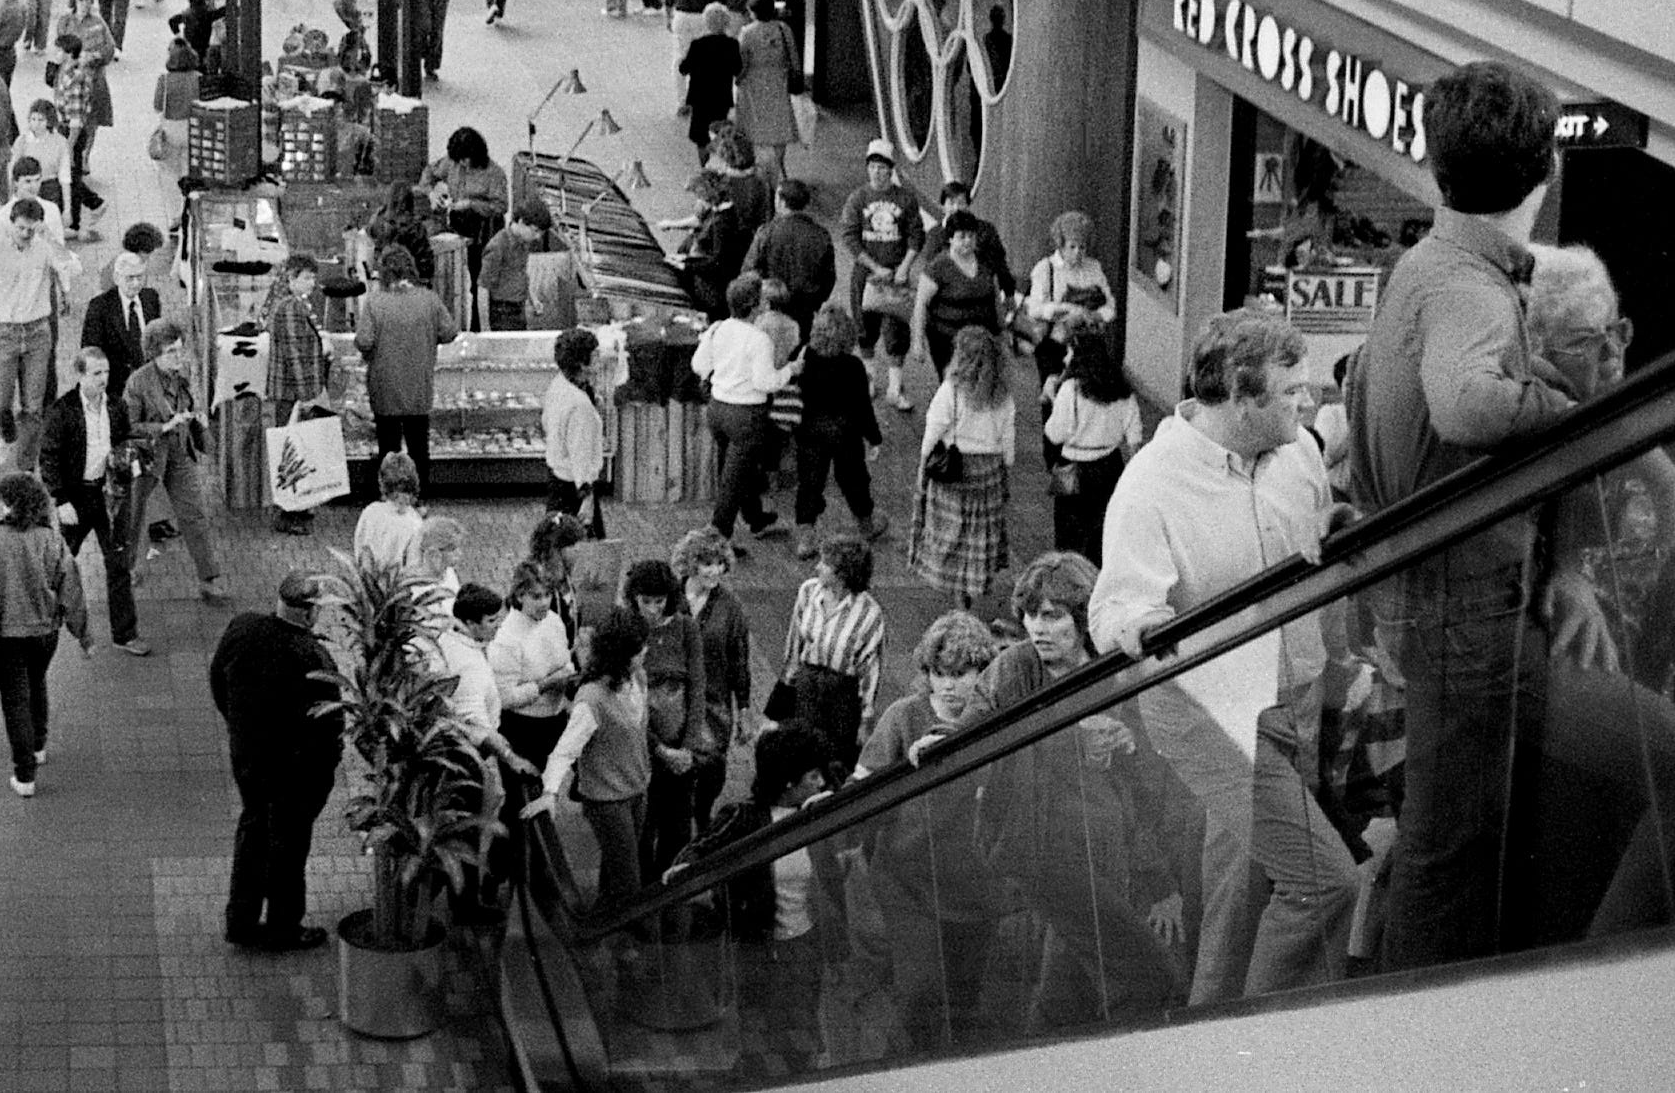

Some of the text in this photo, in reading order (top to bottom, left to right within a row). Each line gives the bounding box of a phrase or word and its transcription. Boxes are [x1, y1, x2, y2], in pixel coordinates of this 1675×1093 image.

[1325, 49, 1427, 163] SHOES
[1553, 114, 1590, 138] XIT
[1291, 278, 1375, 308] SALE
